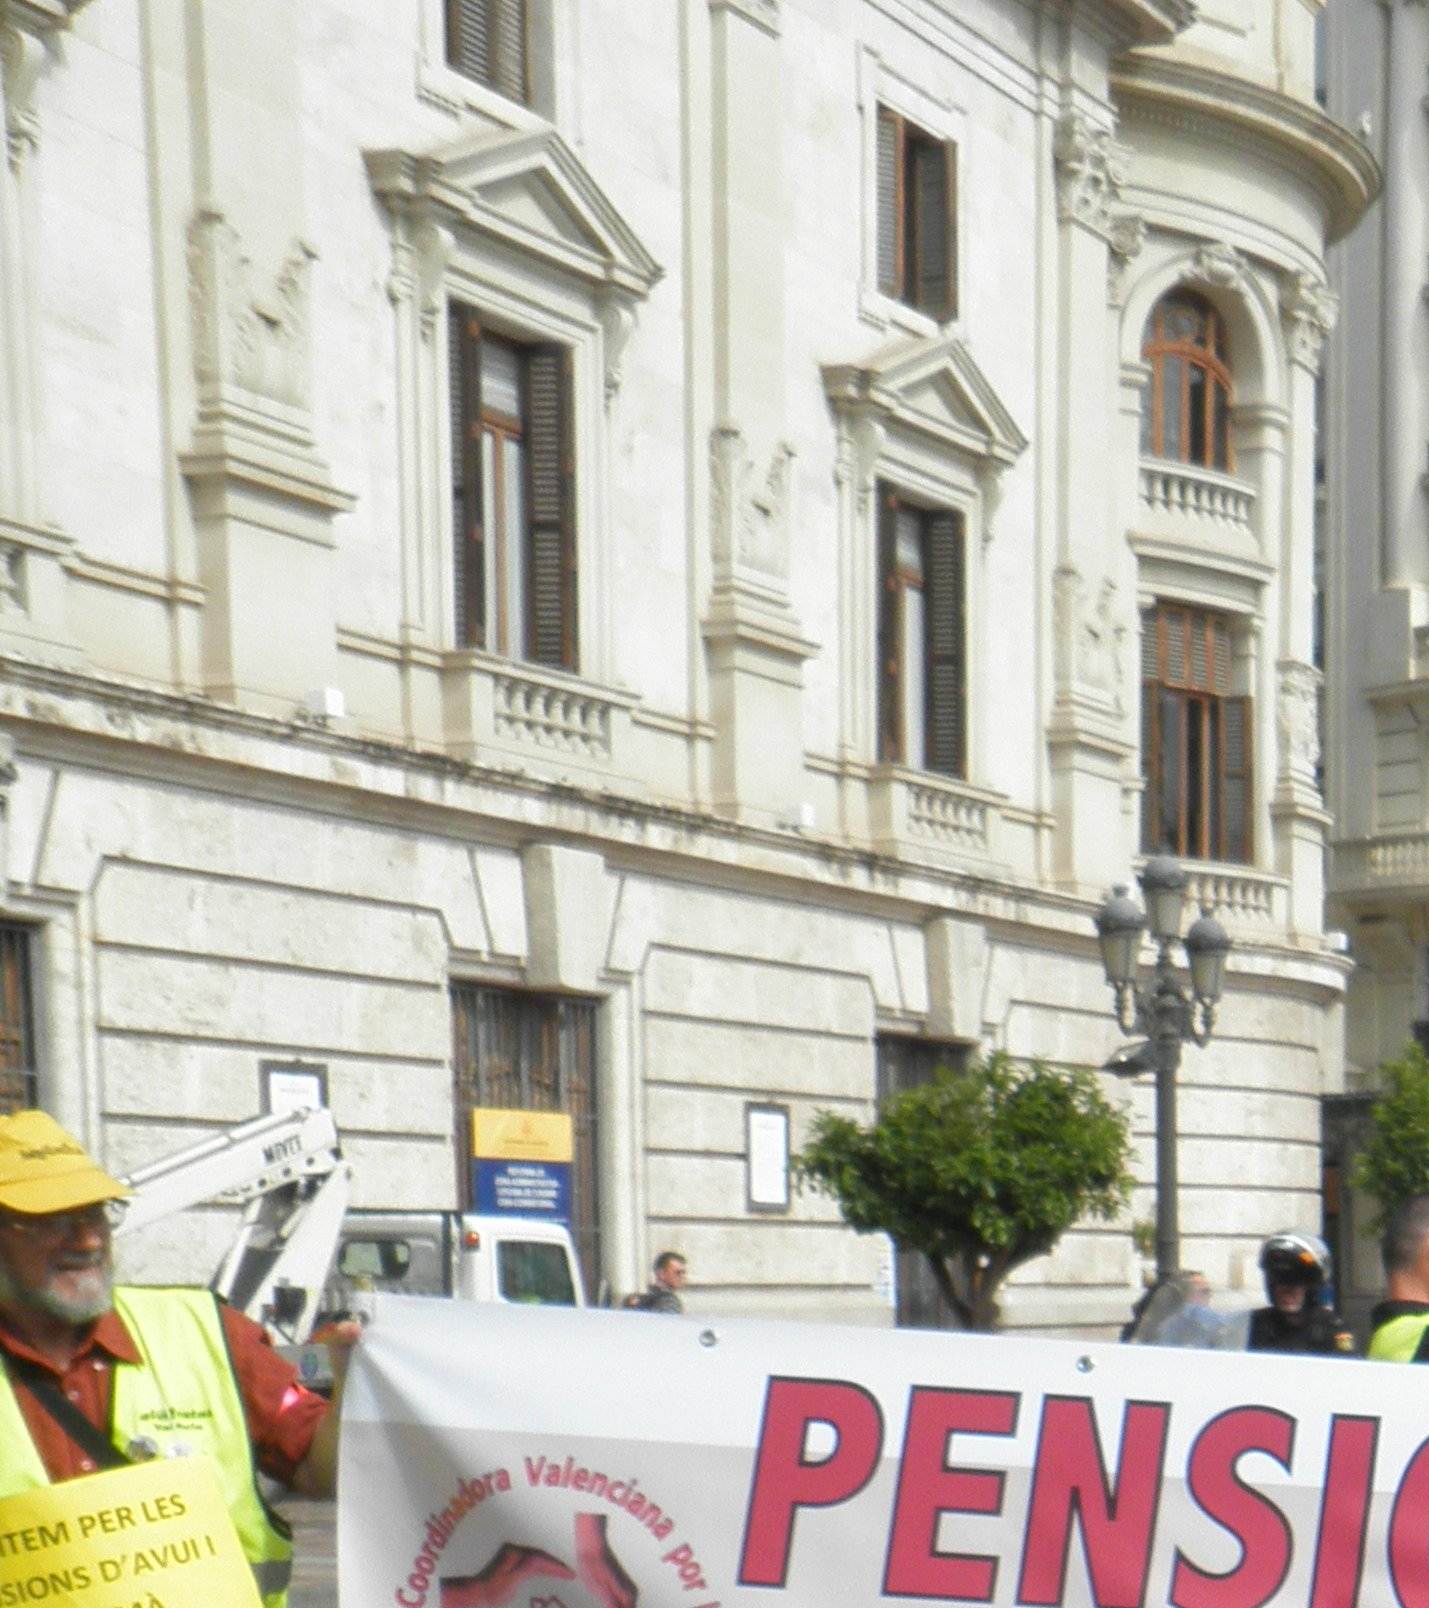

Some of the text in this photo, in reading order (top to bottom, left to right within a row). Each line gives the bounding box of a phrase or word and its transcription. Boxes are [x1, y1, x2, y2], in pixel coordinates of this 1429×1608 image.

[77, 1506, 136, 1540] PER
[140, 1494, 187, 1523] LES
[525, 1455, 675, 1541] Valenciana
[661, 1543, 708, 1592] por
[0, 1534, 217, 1608] SIONS D'AVUI I
